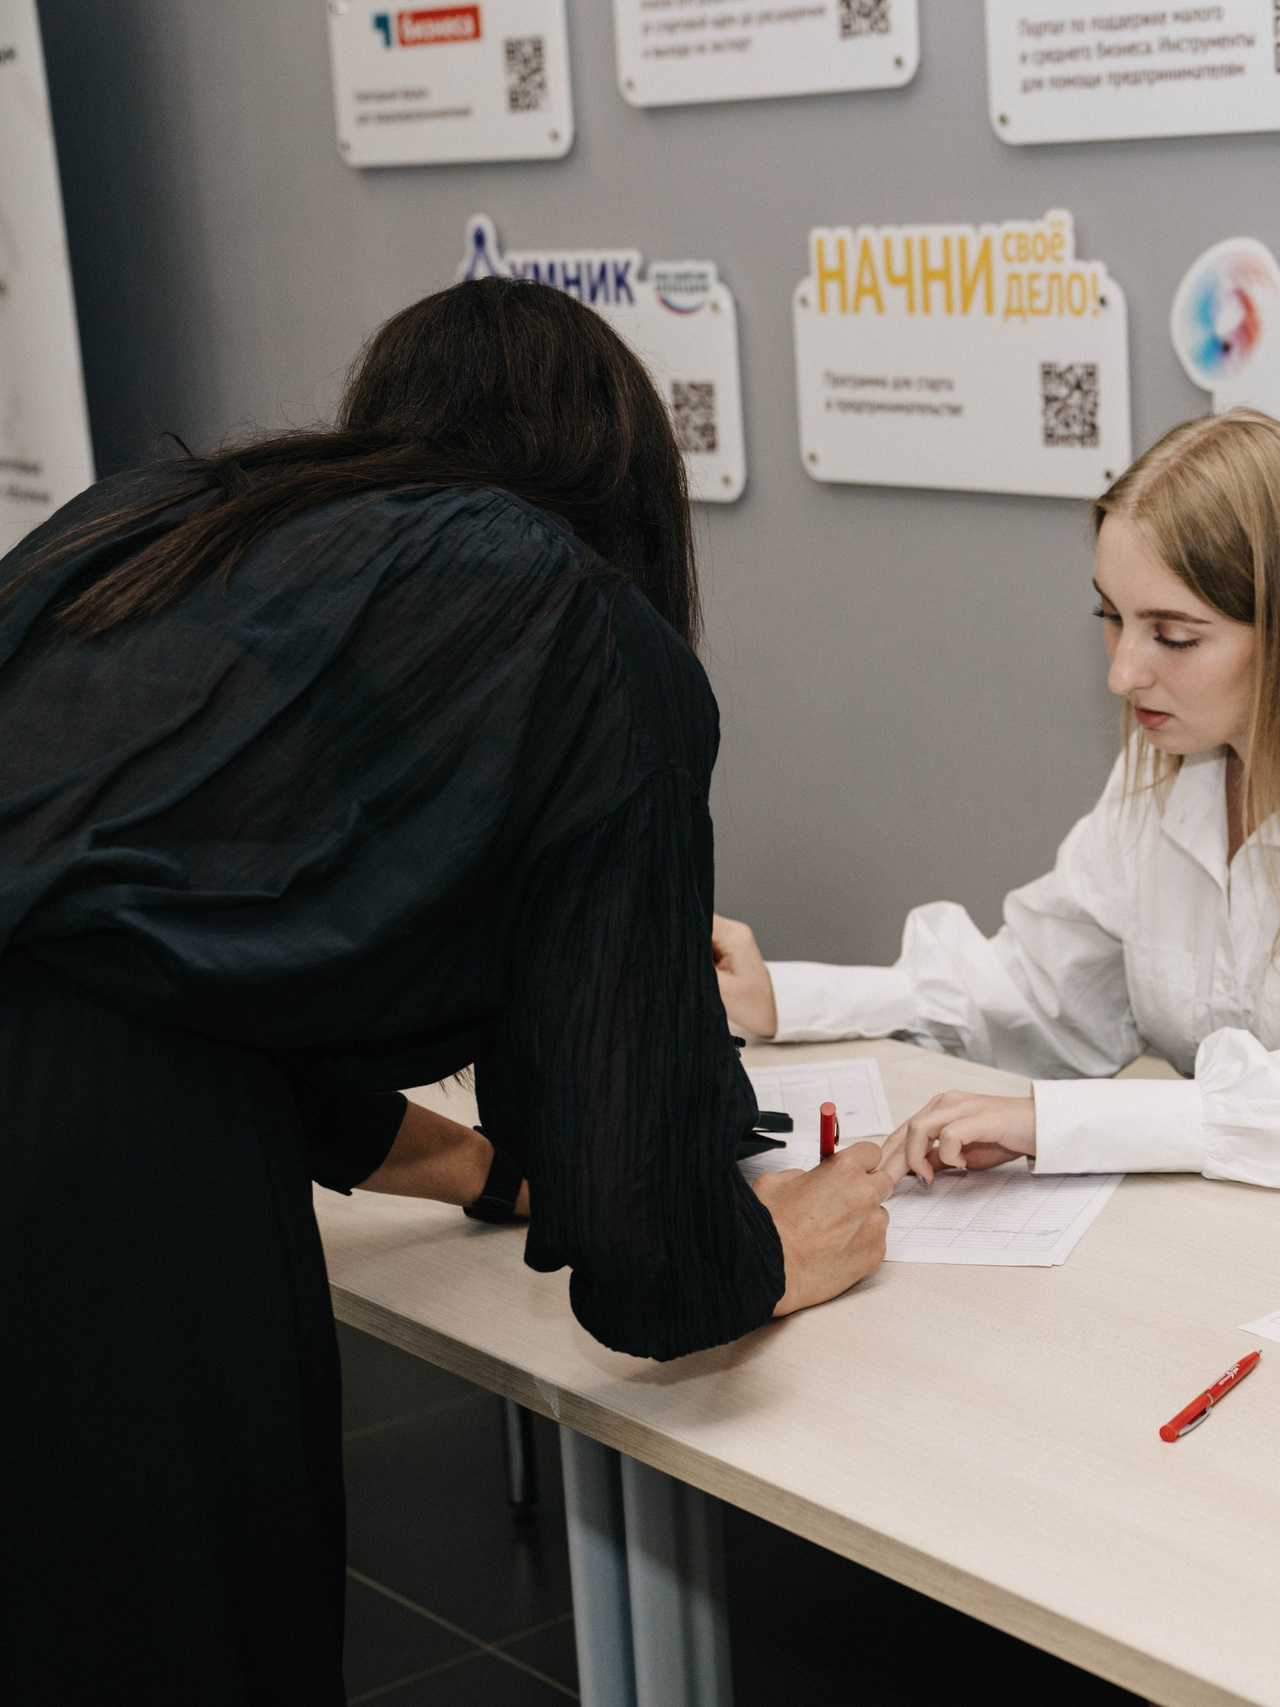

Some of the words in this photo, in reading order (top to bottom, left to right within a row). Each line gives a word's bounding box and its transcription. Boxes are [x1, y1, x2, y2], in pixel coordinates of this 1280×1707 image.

[815, 234, 996, 318] НАЧНИ
[1002, 219, 1066, 264] своё
[1002, 272, 1100, 324] ДЕЛО!
